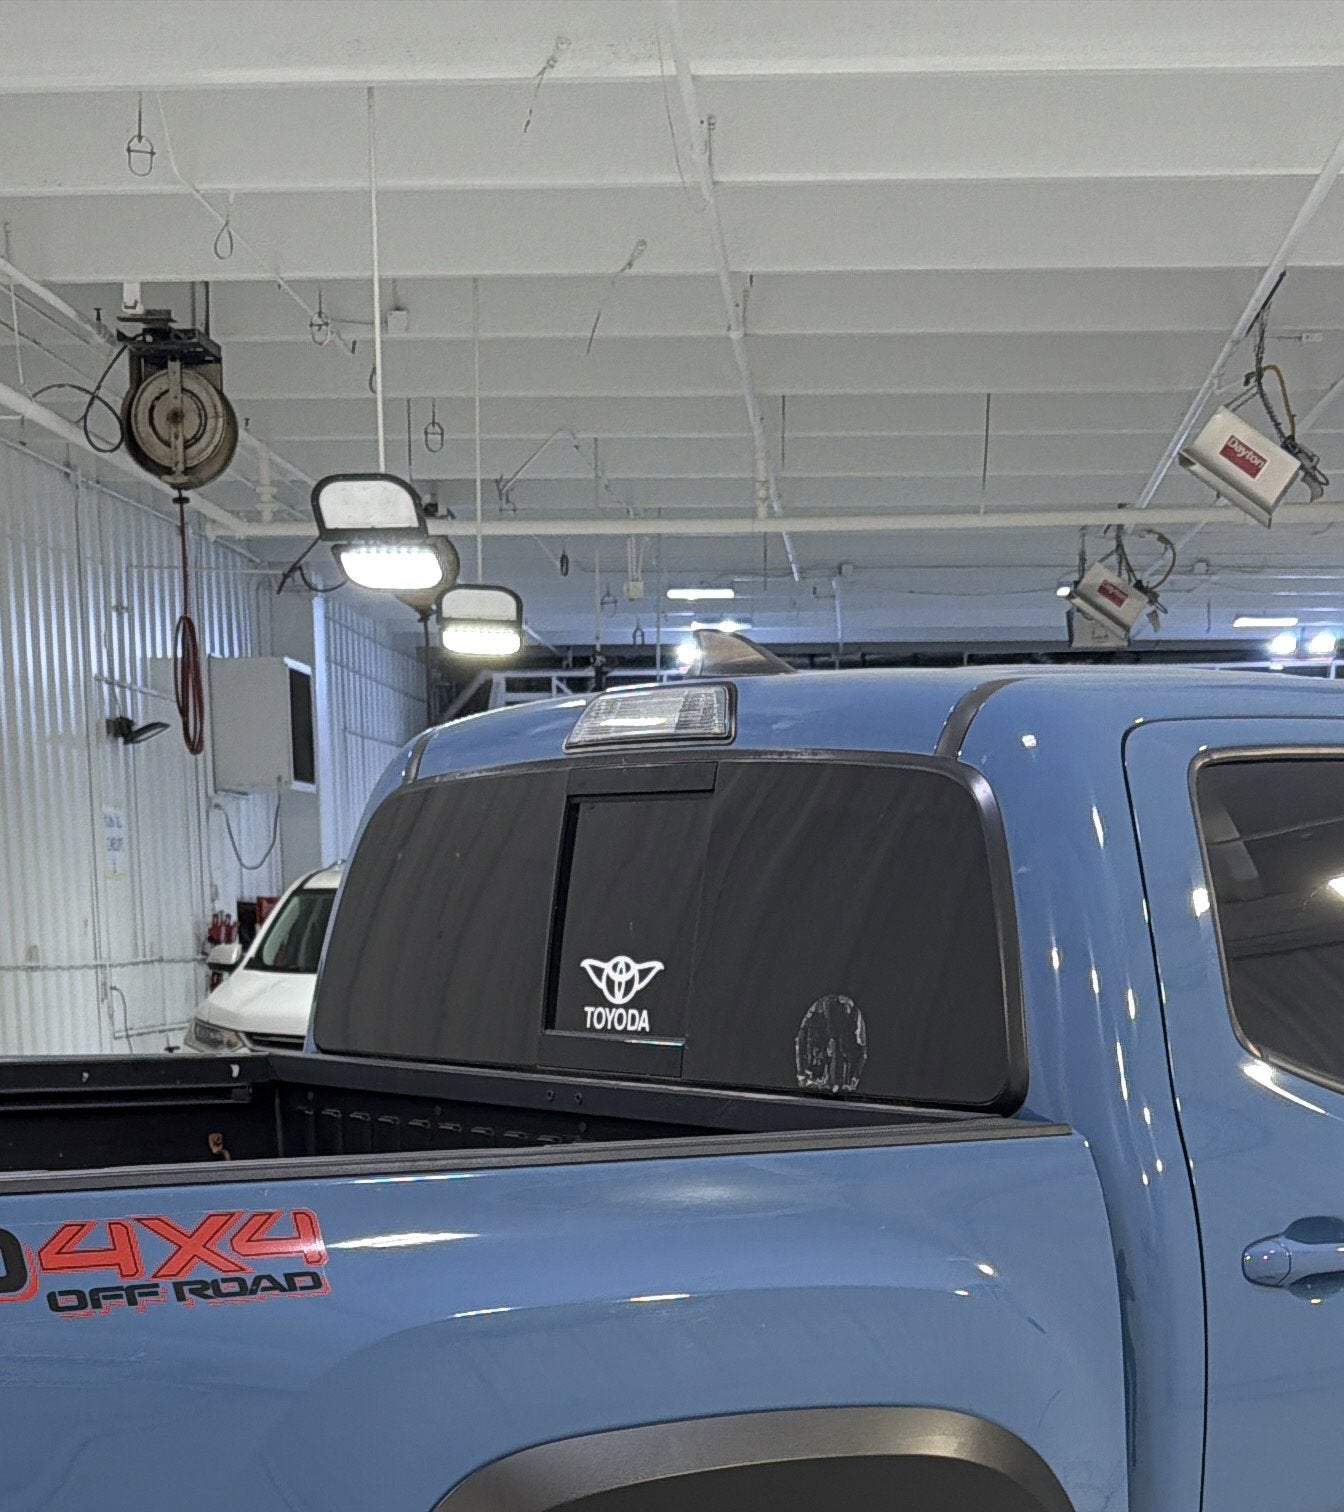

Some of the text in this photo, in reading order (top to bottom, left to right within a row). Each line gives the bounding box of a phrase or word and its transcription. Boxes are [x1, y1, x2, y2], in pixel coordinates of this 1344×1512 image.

[1227, 438, 1265, 469] Dayton
[584, 1006, 650, 1032] TOYODA
[47, 1271, 325, 1314] OFF ROAD
